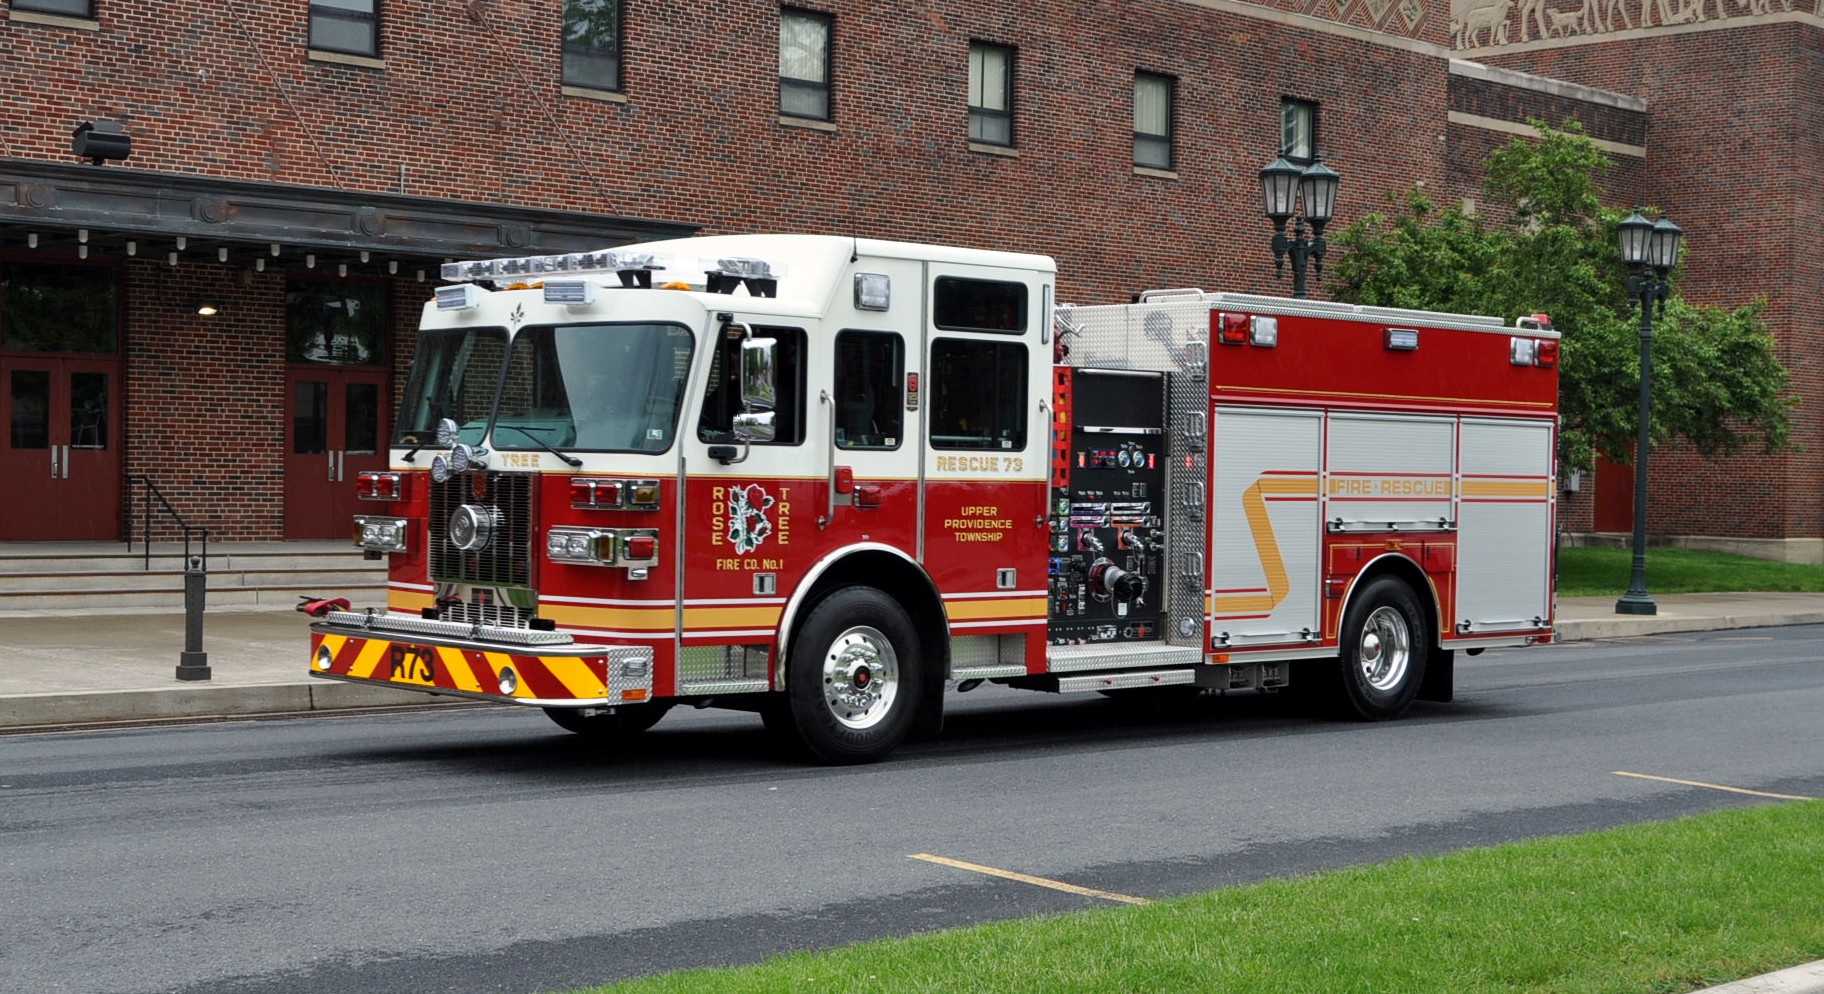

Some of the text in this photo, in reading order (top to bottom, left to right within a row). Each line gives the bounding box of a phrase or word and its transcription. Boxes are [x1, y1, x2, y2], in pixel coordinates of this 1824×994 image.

[501, 453, 540, 468] TREE
[937, 456, 1023, 472] RESCUE 73
[1336, 480, 1445, 495] FIRE RESCUE
[712, 486, 725, 546] ROSE
[778, 487, 791, 545] TREE
[961, 506, 998, 517] UPPER
[944, 519, 1013, 529] PROVIDENCE
[954, 532, 1003, 542] TOWNSHIP
[716, 559, 740, 570] FIRE
[743, 559, 760, 570] CO.
[390, 645, 434, 682] R73
